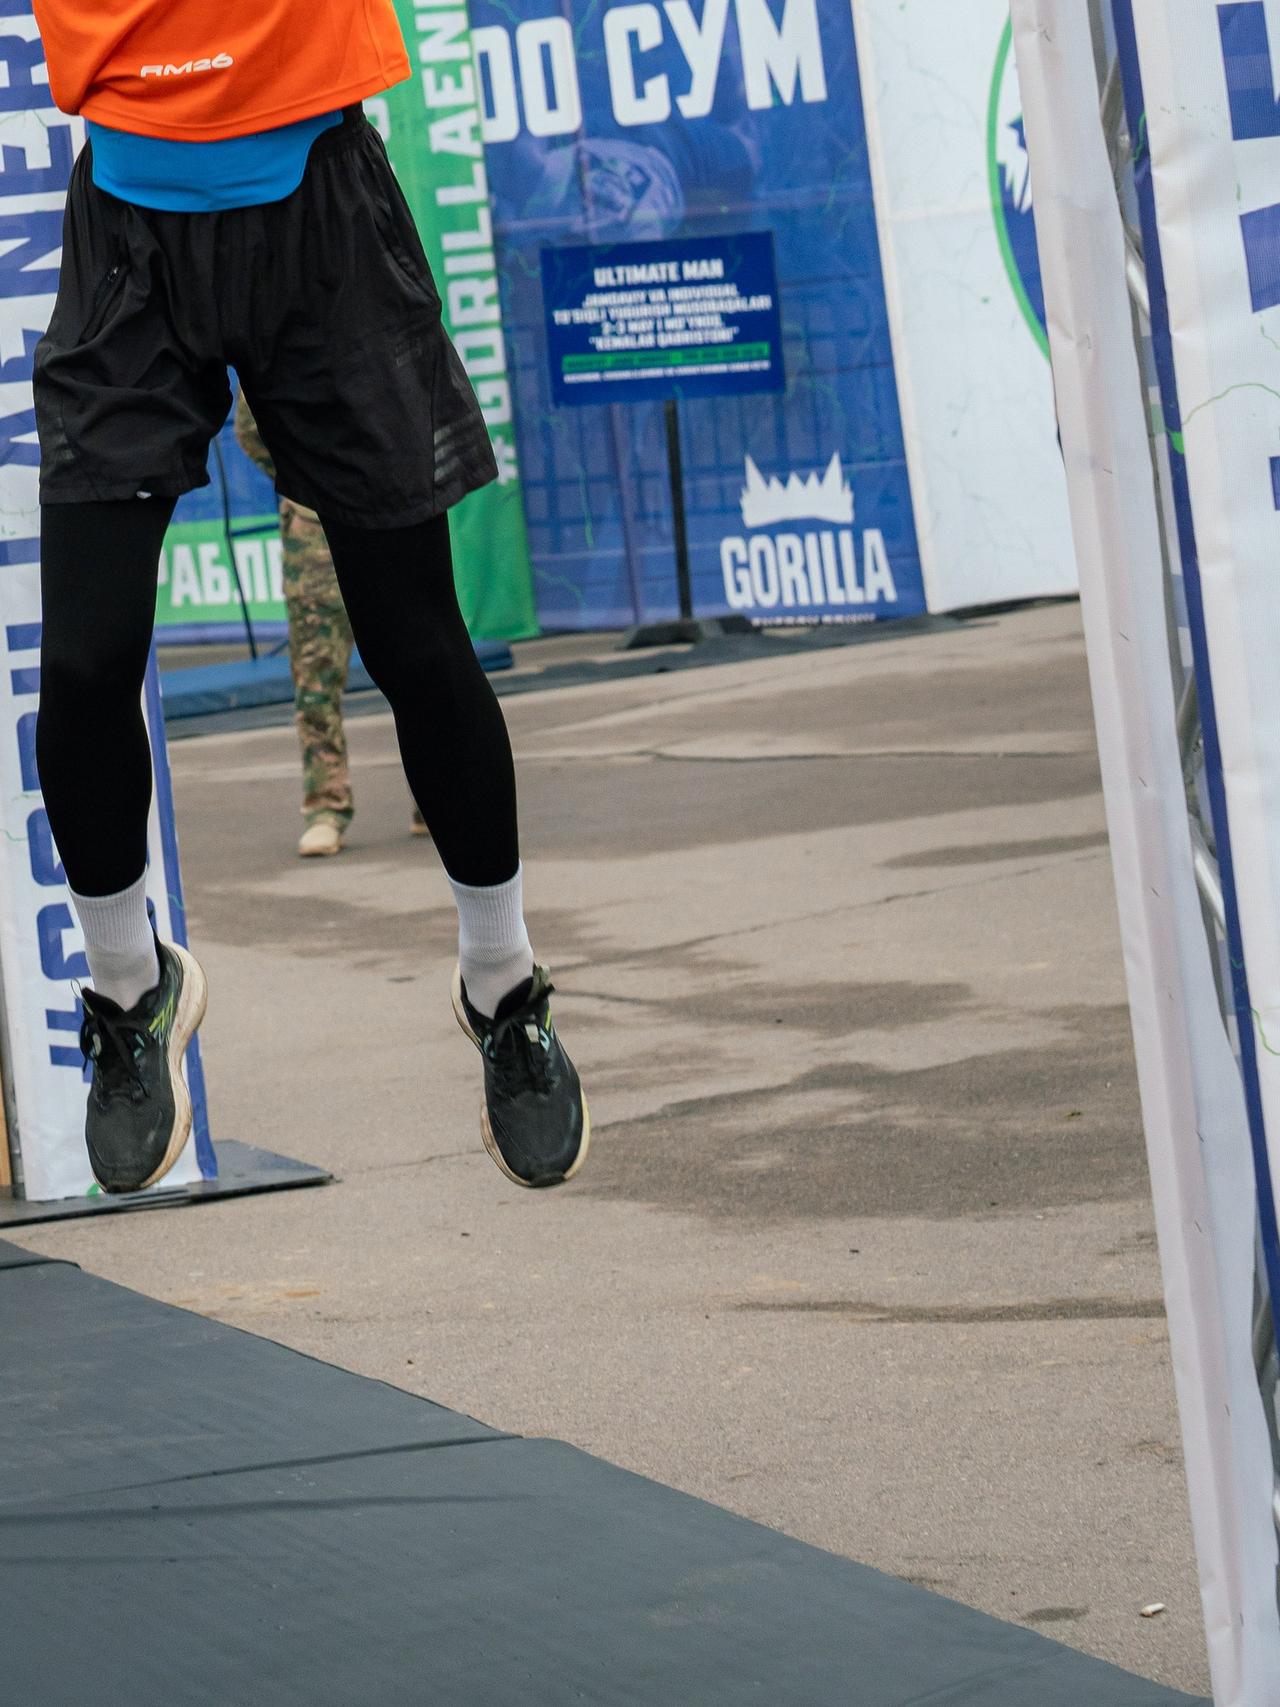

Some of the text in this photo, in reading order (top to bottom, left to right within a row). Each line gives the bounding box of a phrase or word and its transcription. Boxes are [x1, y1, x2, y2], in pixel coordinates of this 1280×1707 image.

[140, 52, 233, 78] RM26
[594, 258, 724, 287] ULTIMATE MAN
[720, 528, 898, 609] GORILLA
